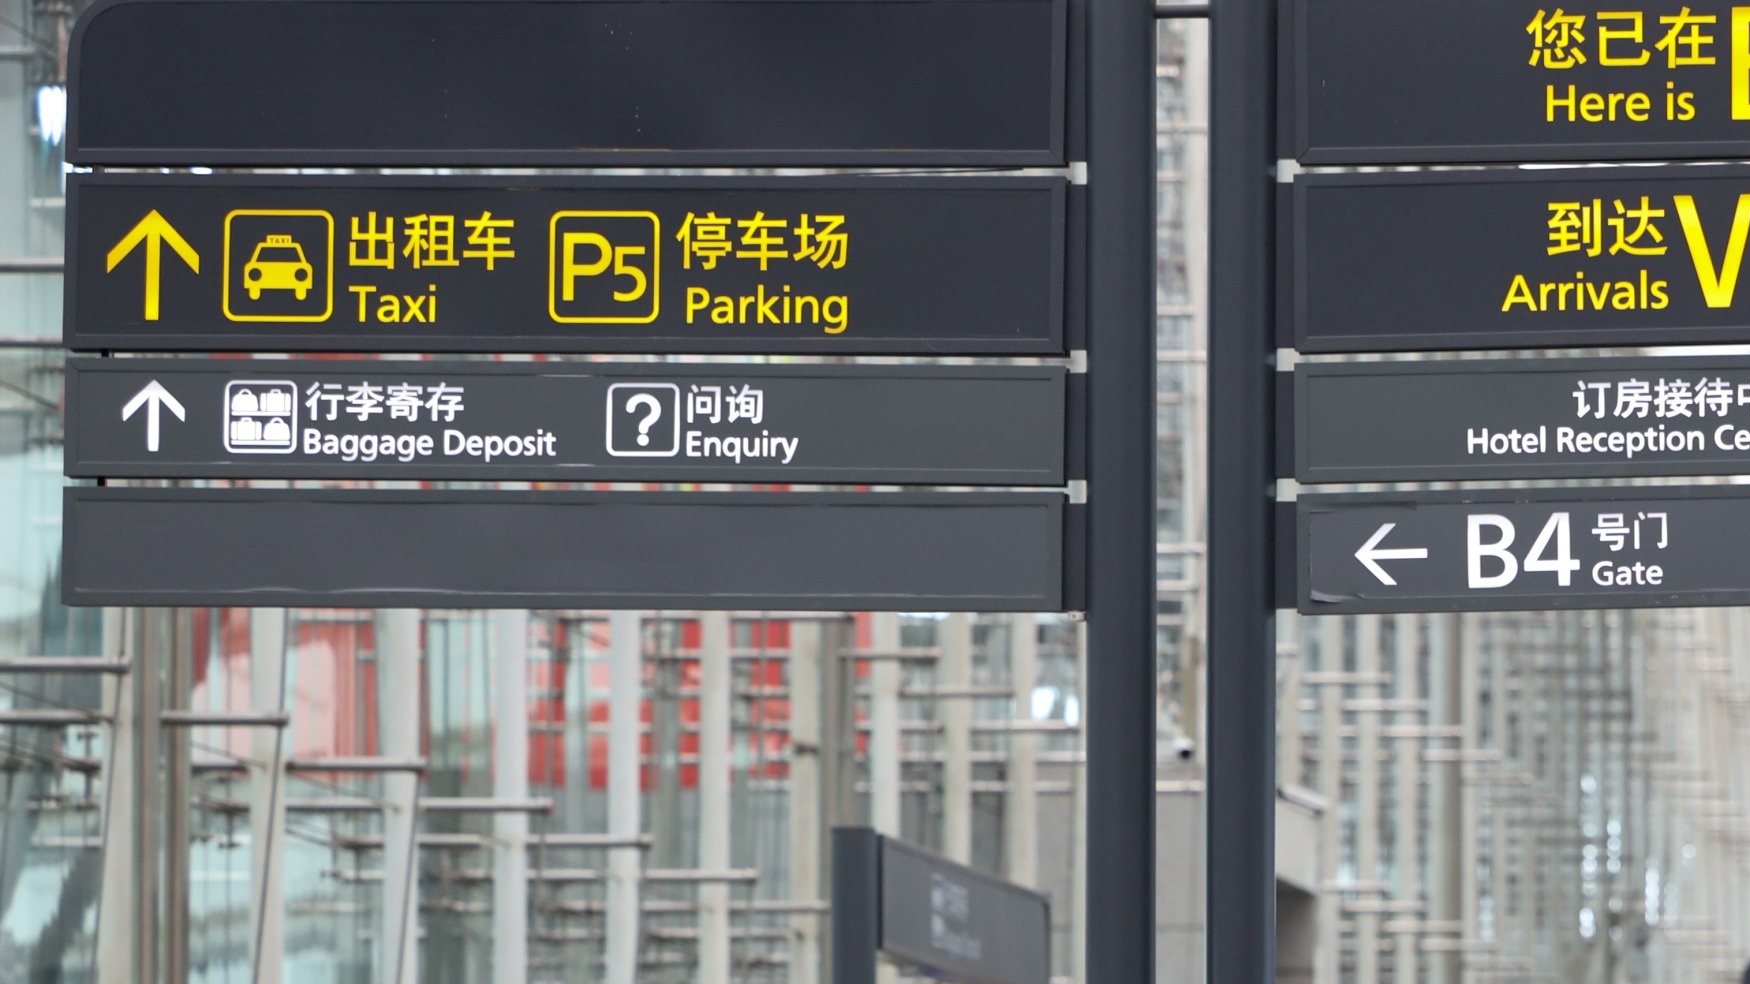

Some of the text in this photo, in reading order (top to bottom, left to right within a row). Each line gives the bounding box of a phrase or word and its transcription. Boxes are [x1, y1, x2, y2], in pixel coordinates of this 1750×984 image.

[1526, 6, 1717, 69] 您已在
[1546, 84, 1651, 122] Here
[1666, 81, 1696, 121] is
[348, 210, 515, 271] 出租车
[676, 210, 849, 271] 停车场
[1547, 195, 1668, 258] 到达
[562, 232, 647, 302] P5
[348, 284, 437, 323] Taxi
[686, 284, 848, 334] Parking
[1501, 269, 1669, 311] Arrivals
[304, 381, 465, 423] 行李寄存
[686, 383, 764, 425] 问询
[303, 427, 557, 464] Baggage Deposit
[685, 429, 799, 465] Enquiry
[1467, 425, 1547, 455] Hotel
[1556, 425, 1705, 459] Reception
[1466, 511, 1668, 589] B4 号门
[1591, 560, 1664, 587] Gate
